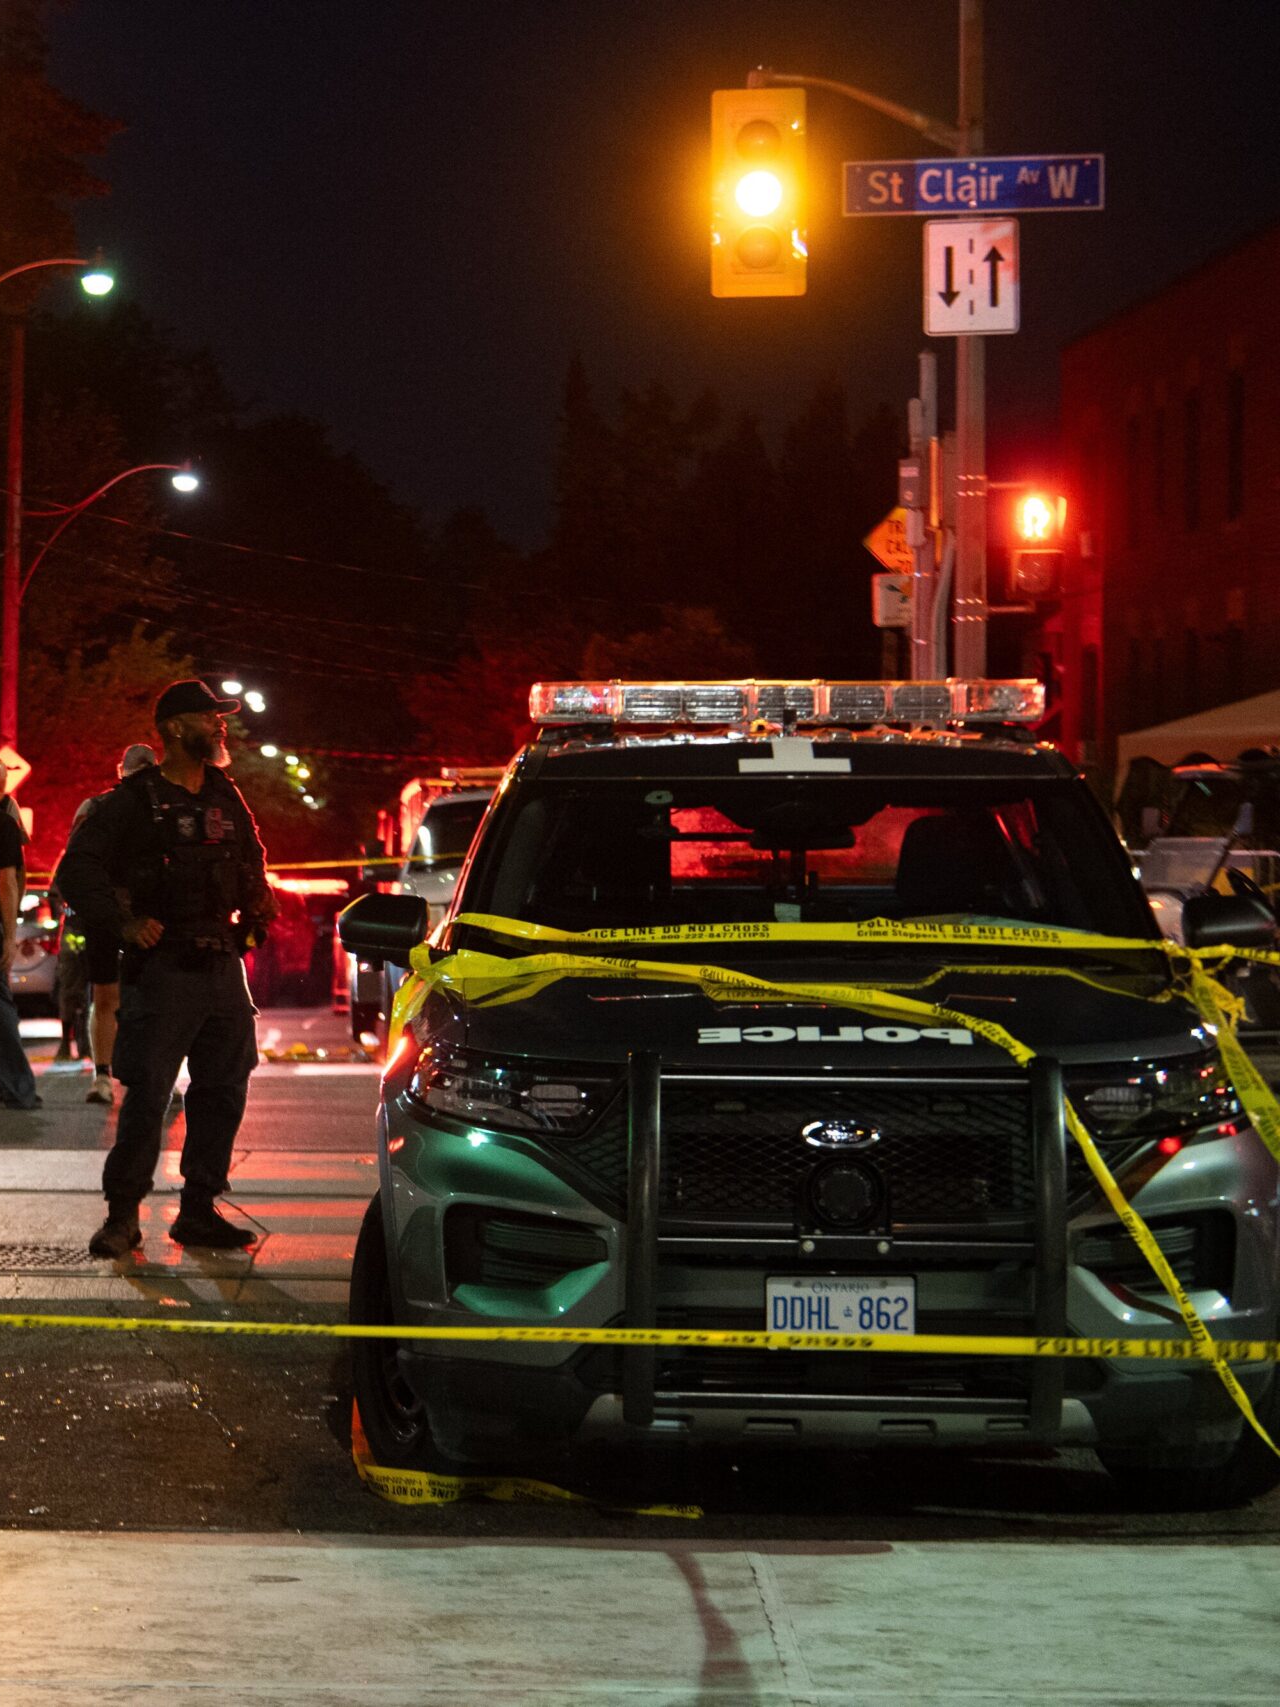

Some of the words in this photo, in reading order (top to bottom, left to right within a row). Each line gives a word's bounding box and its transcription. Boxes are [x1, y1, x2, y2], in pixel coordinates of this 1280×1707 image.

[869, 170, 903, 204] St
[919, 164, 1004, 203] Clair
[1017, 166, 1040, 184] Av
[1048, 165, 1078, 199] W
[624, 927, 656, 936] LINE
[663, 926, 681, 934] DO
[688, 924, 714, 932] NOT
[722, 924, 770, 932] CROSS
[953, 925, 970, 934] DO
[978, 926, 1004, 935] NOT
[1012, 928, 1060, 939] CROSS
[773, 1296, 839, 1330] DDHL
[859, 1296, 908, 1331] 862
[1037, 1337, 1130, 1356] POLICE
